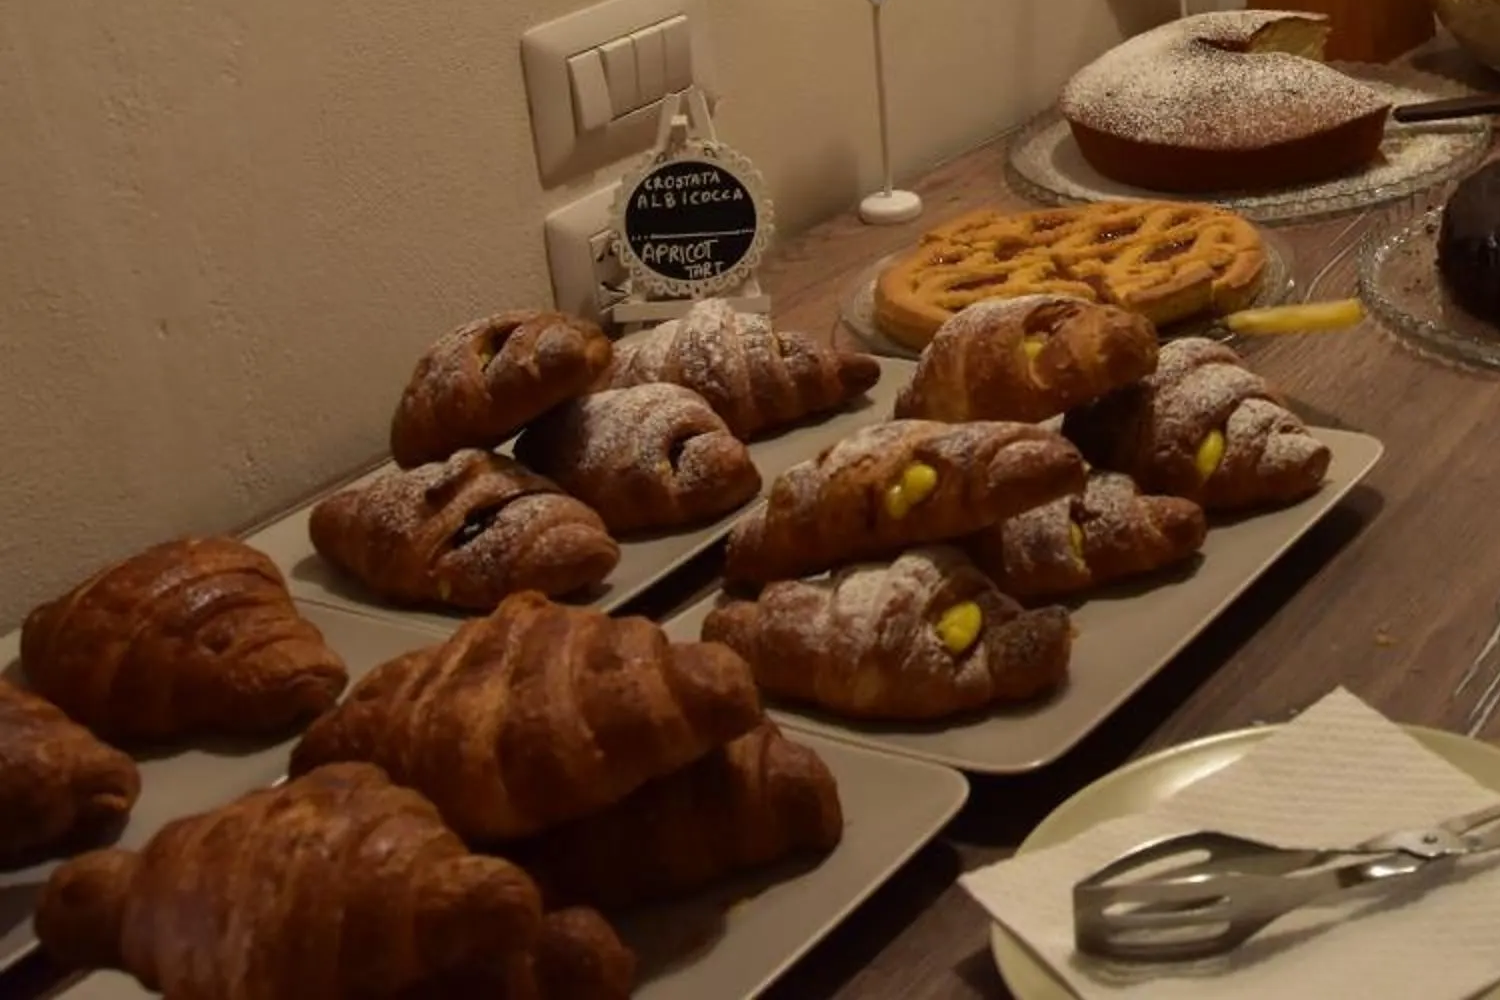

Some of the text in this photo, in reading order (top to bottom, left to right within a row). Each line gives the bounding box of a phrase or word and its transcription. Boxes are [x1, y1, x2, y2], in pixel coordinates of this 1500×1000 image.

[644, 170, 721, 190] CROSTATA
[637, 188, 743, 209] ALBICOCCA
[641, 240, 718, 264] APRICOT
[685, 261, 724, 279] TART
